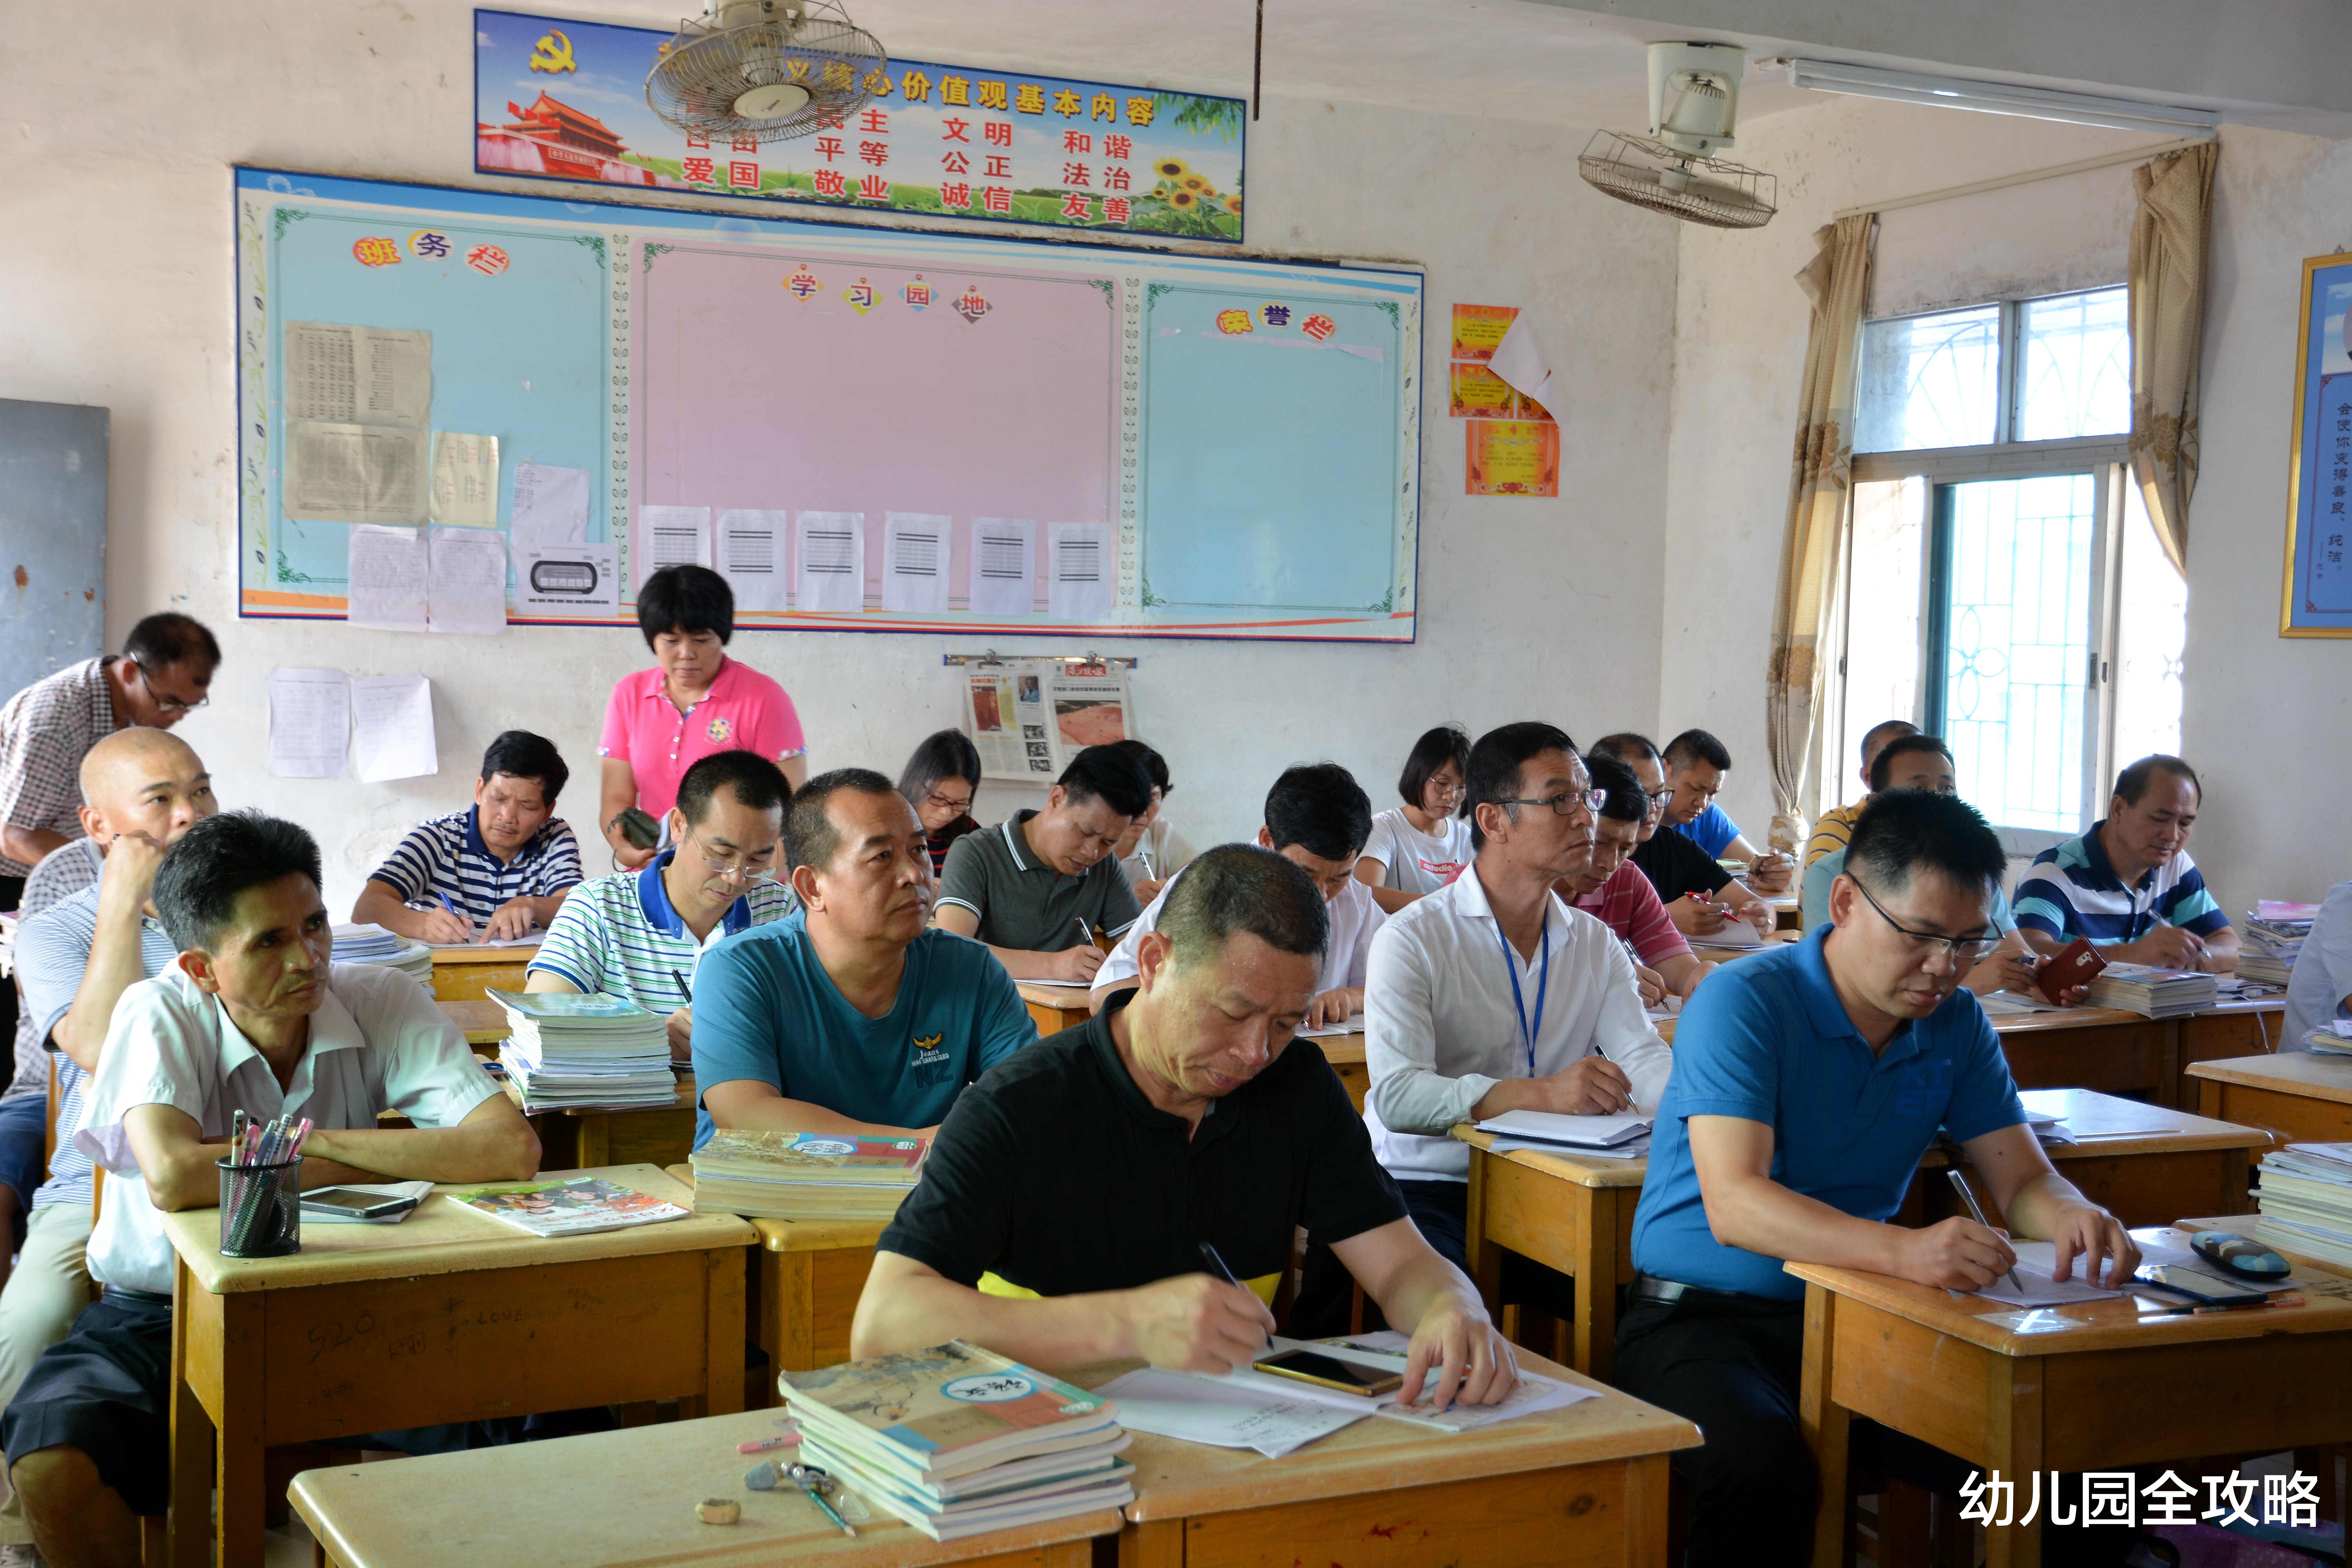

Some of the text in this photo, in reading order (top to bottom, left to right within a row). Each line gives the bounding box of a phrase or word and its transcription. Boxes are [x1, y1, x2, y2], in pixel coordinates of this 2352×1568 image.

[817, 103, 1132, 160] 民主 文明 和谐
[815, 137, 889, 166] 平等
[942, 151, 1013, 179] 公正
[1063, 162, 1132, 191] 法治
[683, 157, 1132, 223] 爱国 敬业 诚信 友善
[358, 232, 508, 276] 班务栏
[791, 273, 986, 316] 学习园地
[1221, 304, 1334, 341] 荣誉栏
